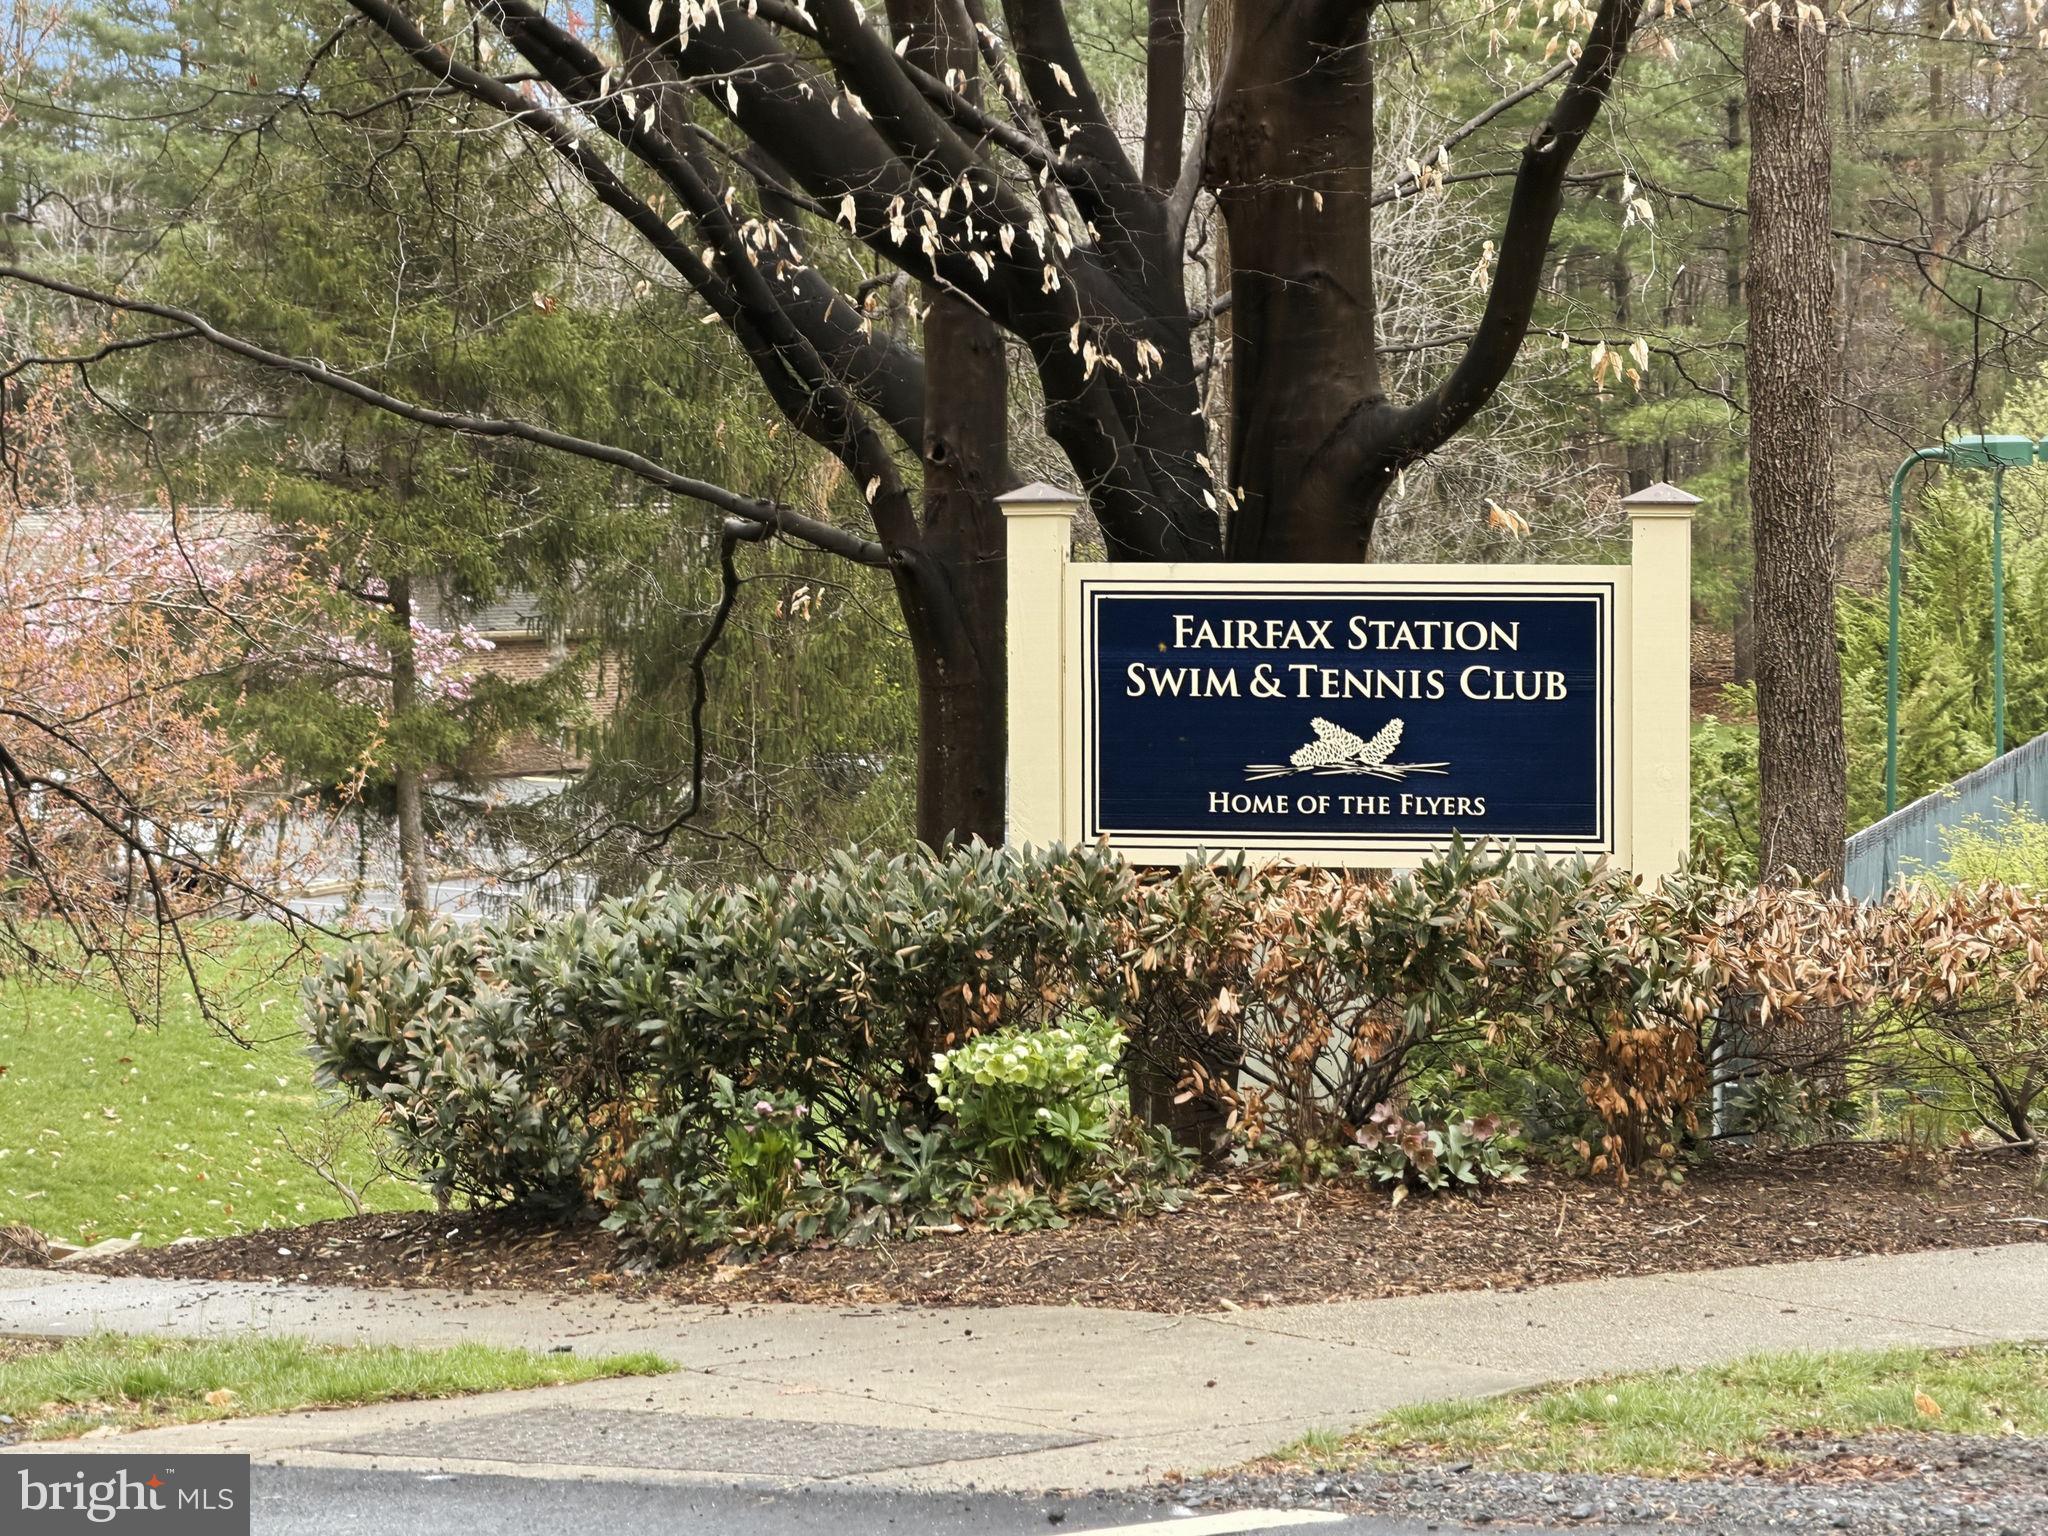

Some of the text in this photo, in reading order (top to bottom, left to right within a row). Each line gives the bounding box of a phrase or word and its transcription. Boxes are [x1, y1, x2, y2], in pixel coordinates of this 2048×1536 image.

[1173, 614, 1521, 652] FAIRFAX STATION
[1126, 663, 1567, 702] SWIM & TENNIS CLUB
[1208, 791, 1486, 817] HOME OF THE FLYERS
